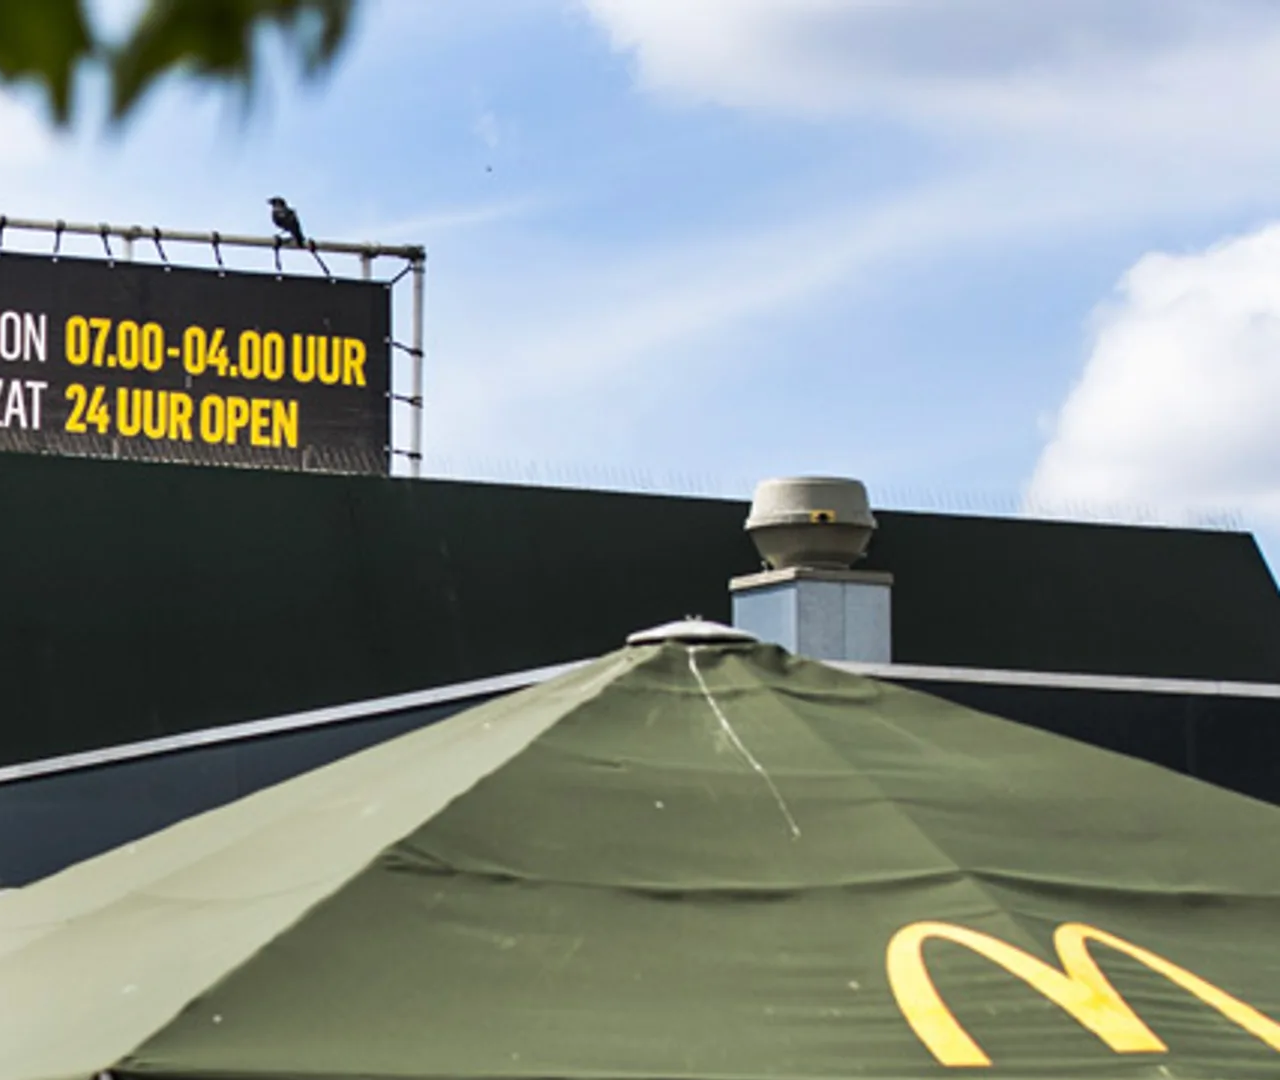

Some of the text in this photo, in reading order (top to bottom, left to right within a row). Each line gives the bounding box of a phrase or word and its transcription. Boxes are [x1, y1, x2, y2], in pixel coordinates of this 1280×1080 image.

[292, 333, 367, 386] UUR
[65, 383, 111, 434] 24
[116, 386, 193, 442] UUR
[200, 394, 299, 449] OPEN
